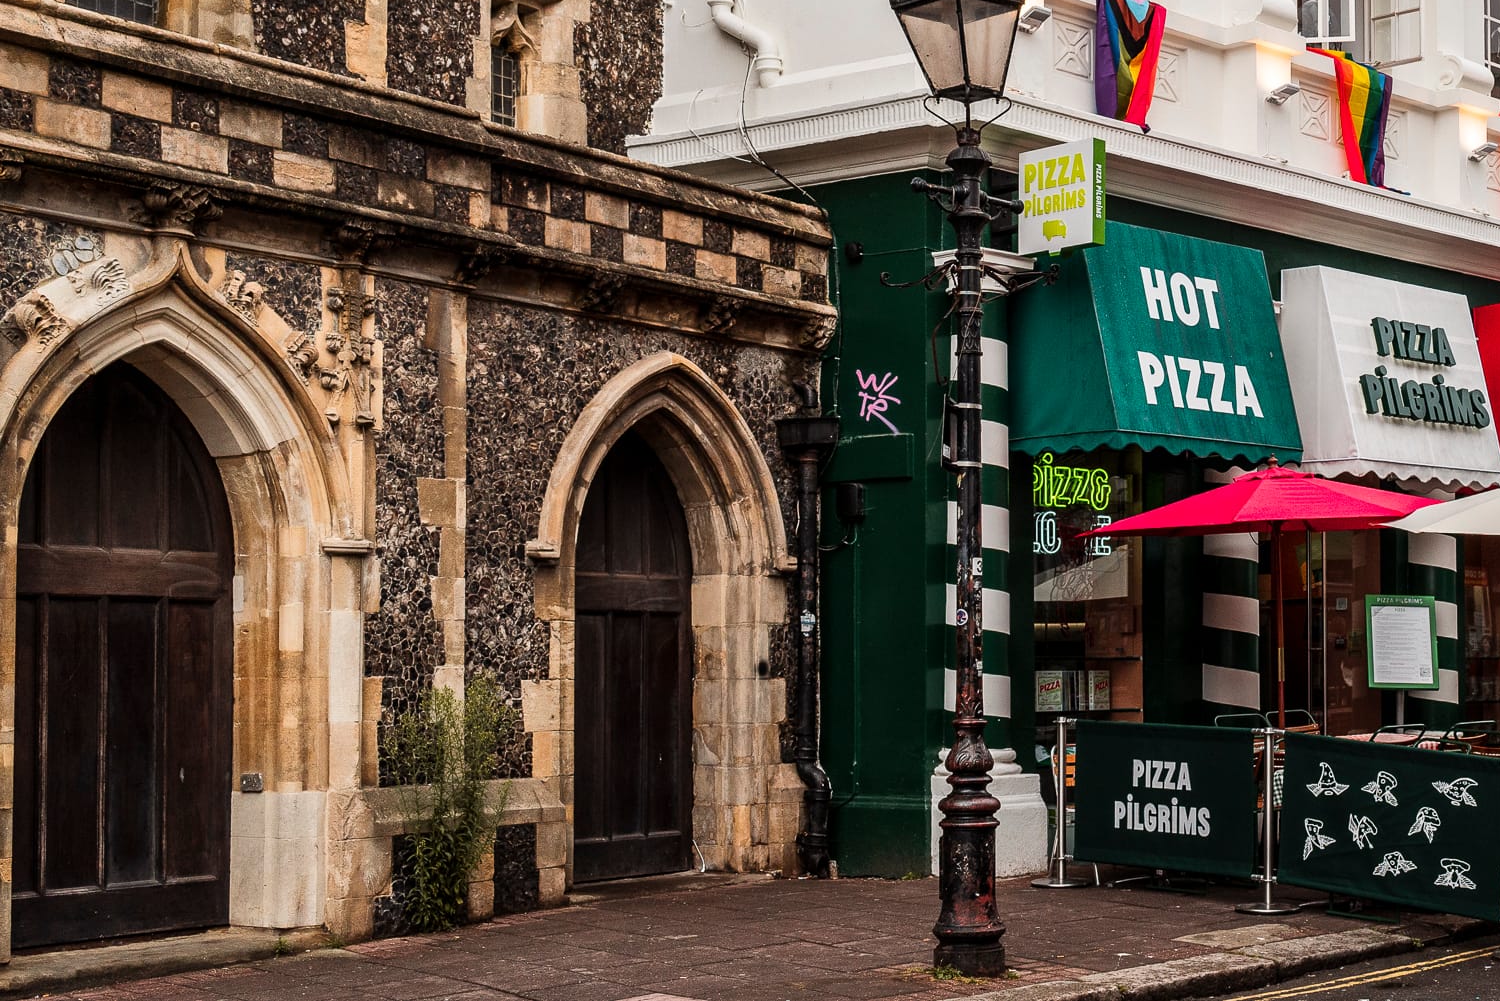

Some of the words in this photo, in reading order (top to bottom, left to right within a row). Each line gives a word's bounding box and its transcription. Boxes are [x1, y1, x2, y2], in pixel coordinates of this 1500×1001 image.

[1024, 152, 1086, 193] PIZZA
[1140, 266, 1220, 330] HOT
[1371, 317, 1456, 367] PIZZA
[1137, 350, 1264, 418] PIZZA
[1040, 679, 1061, 693] PIZZA
[1132, 759, 1192, 791] PIZZA
